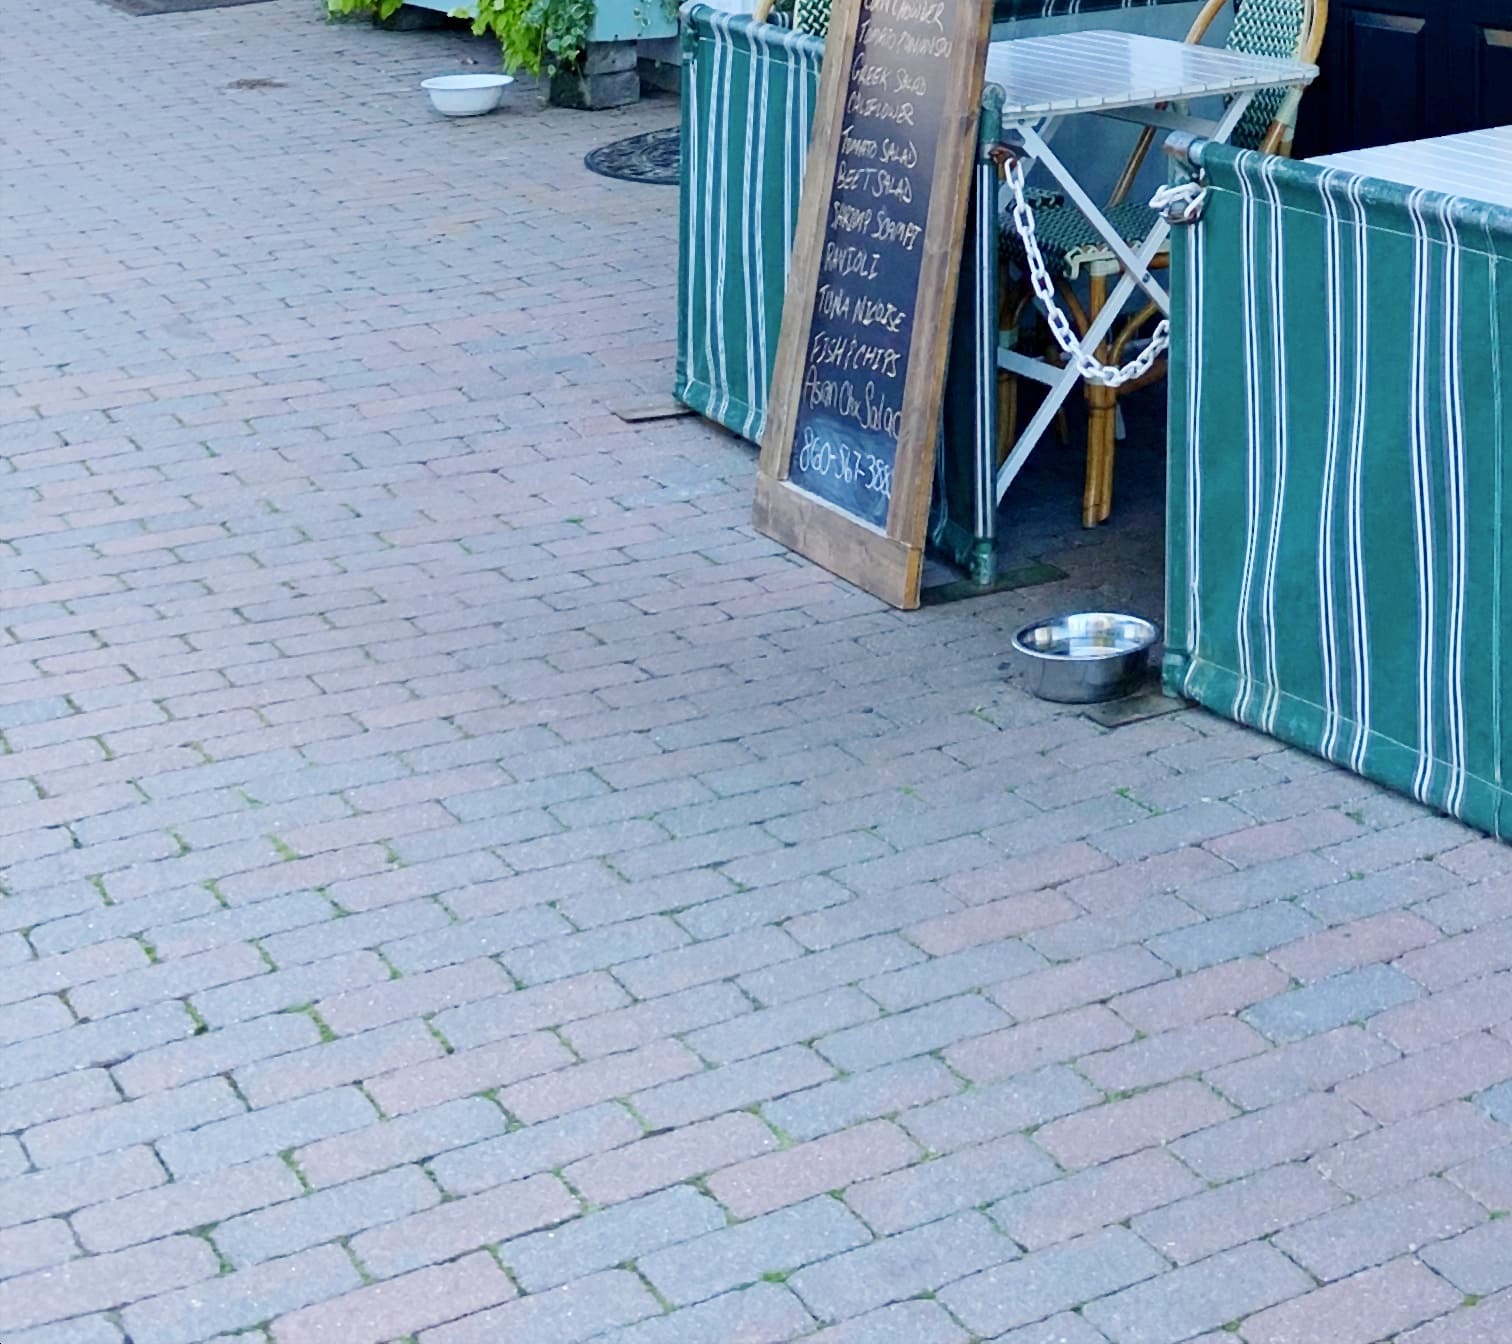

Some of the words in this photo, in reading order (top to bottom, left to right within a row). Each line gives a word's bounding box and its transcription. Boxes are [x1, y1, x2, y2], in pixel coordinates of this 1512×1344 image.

[852, 52, 891, 91] GREEK
[841, 125, 877, 159] TOMATO
[879, 138, 918, 169] SALAD
[837, 161, 877, 190] BEET
[872, 169, 912, 203] SALAD
[824, 242, 881, 280] RAVIOLI
[819, 284, 850, 320] TUNA
[811, 331, 847, 366] FISH
[854, 343, 901, 378] CHIPS
